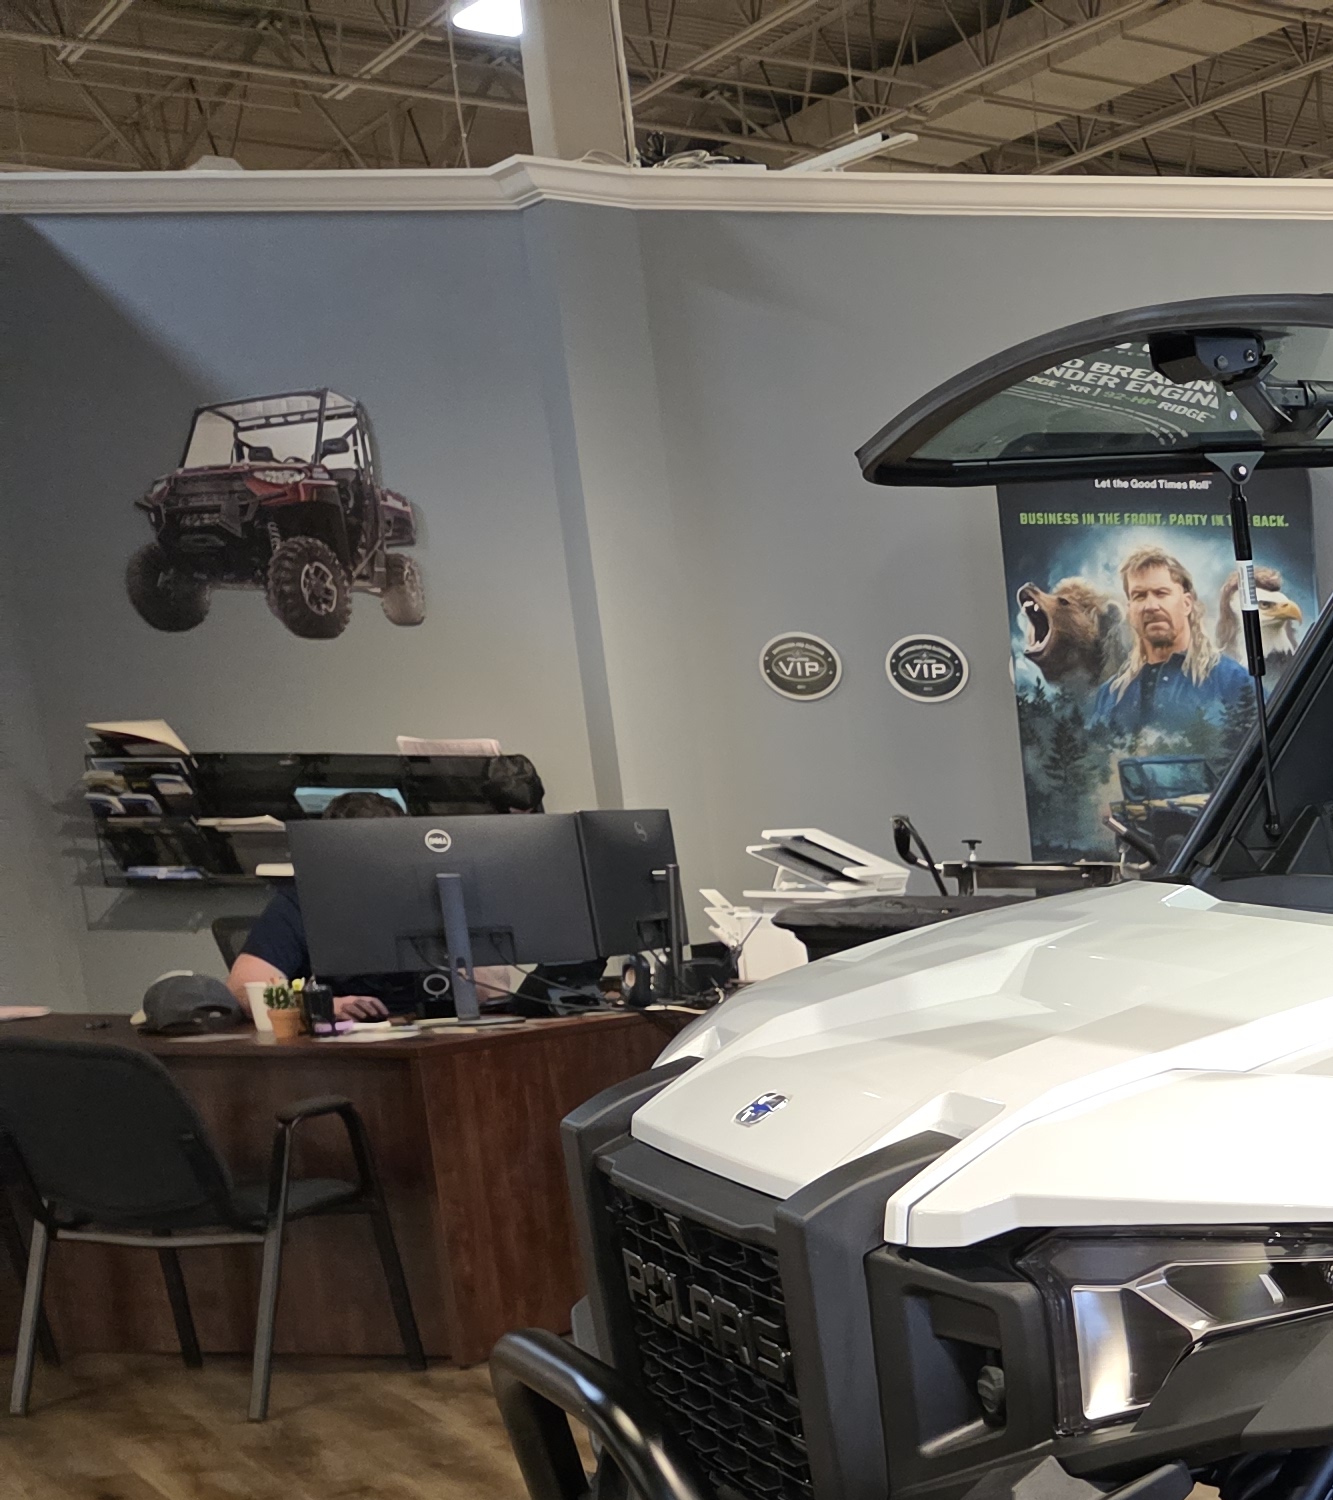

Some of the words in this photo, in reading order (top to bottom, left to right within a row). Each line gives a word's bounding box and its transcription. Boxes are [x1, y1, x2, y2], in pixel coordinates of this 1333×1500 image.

[1094, 479, 1111, 489] Let
[1112, 479, 1129, 489] the
[1130, 479, 1157, 490] Good
[1158, 479, 1188, 490] Times
[1019, 512, 1080, 526] BUSINESS
[1082, 512, 1095, 526] IN
[1097, 512, 1122, 526] THE
[1169, 513, 1208, 527] PARTY
[778, 661, 820, 676] VIP
[904, 662, 946, 679] VIP
